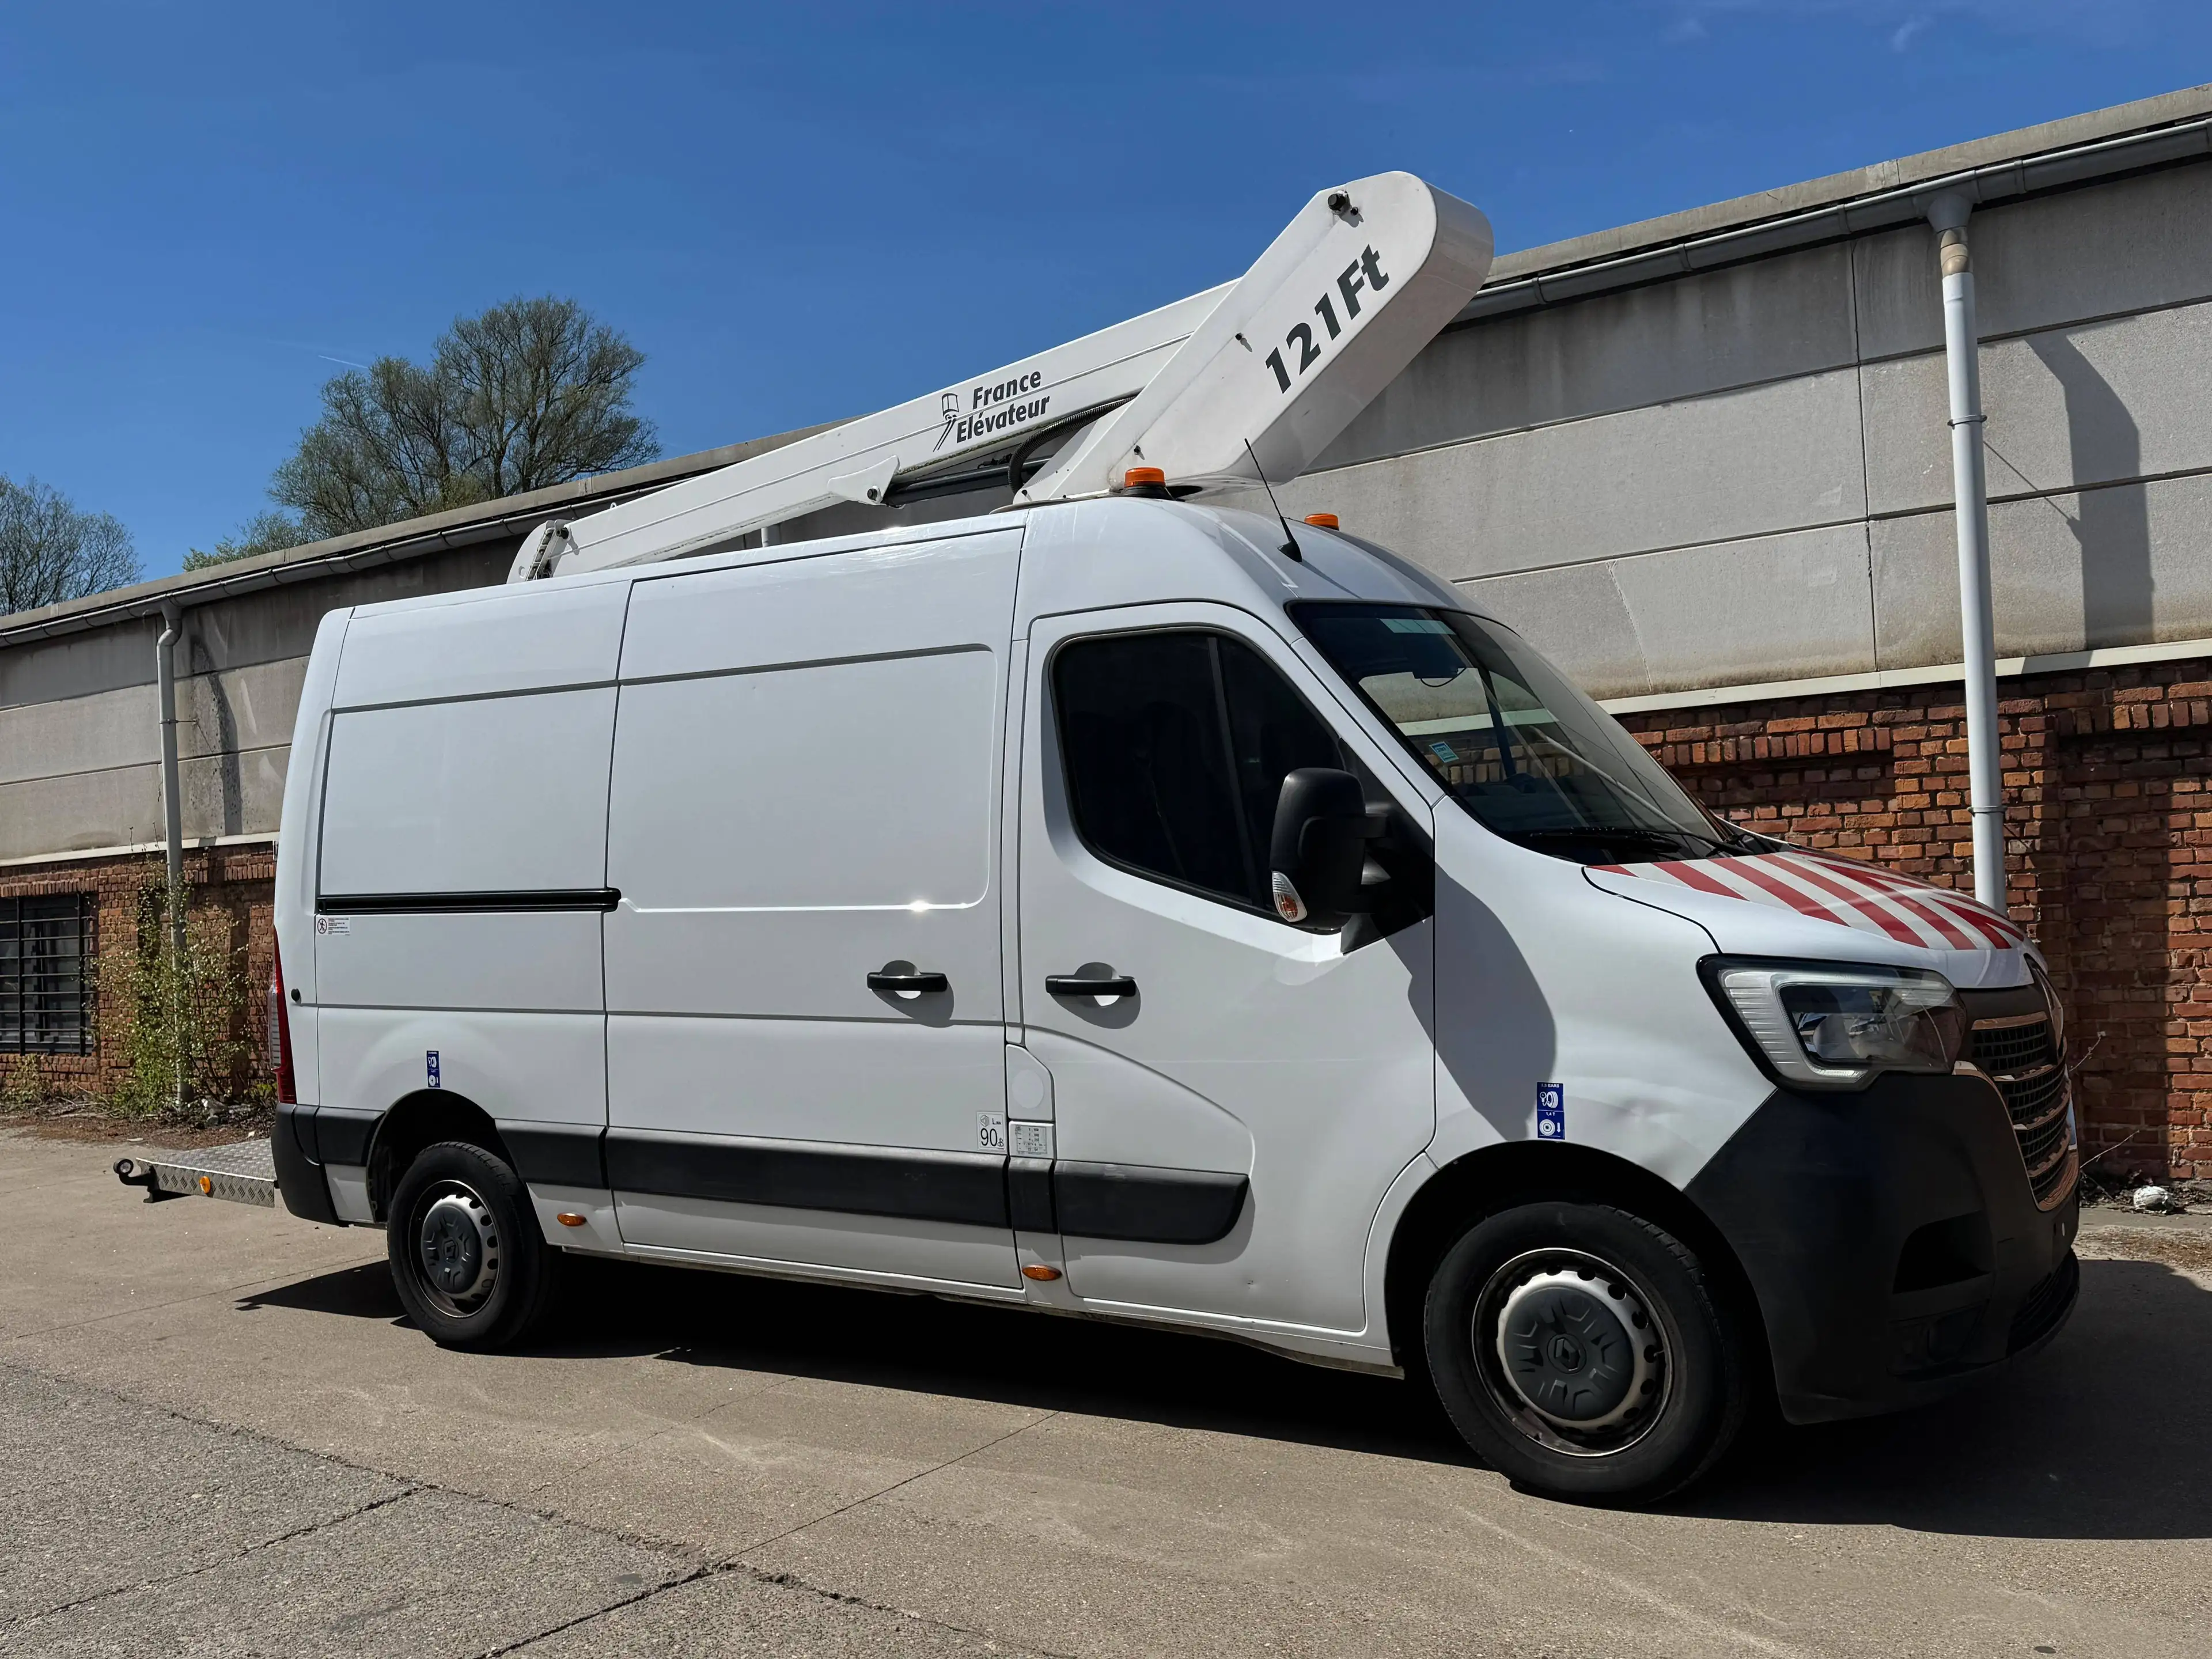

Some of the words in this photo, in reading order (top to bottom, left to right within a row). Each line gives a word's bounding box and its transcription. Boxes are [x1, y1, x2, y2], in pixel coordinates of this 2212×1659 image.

[1265, 244, 1389, 394] 121Ft
[973, 371, 1041, 410] France
[957, 396, 1050, 443] Elévateur
[980, 1128, 998, 1146] 90
